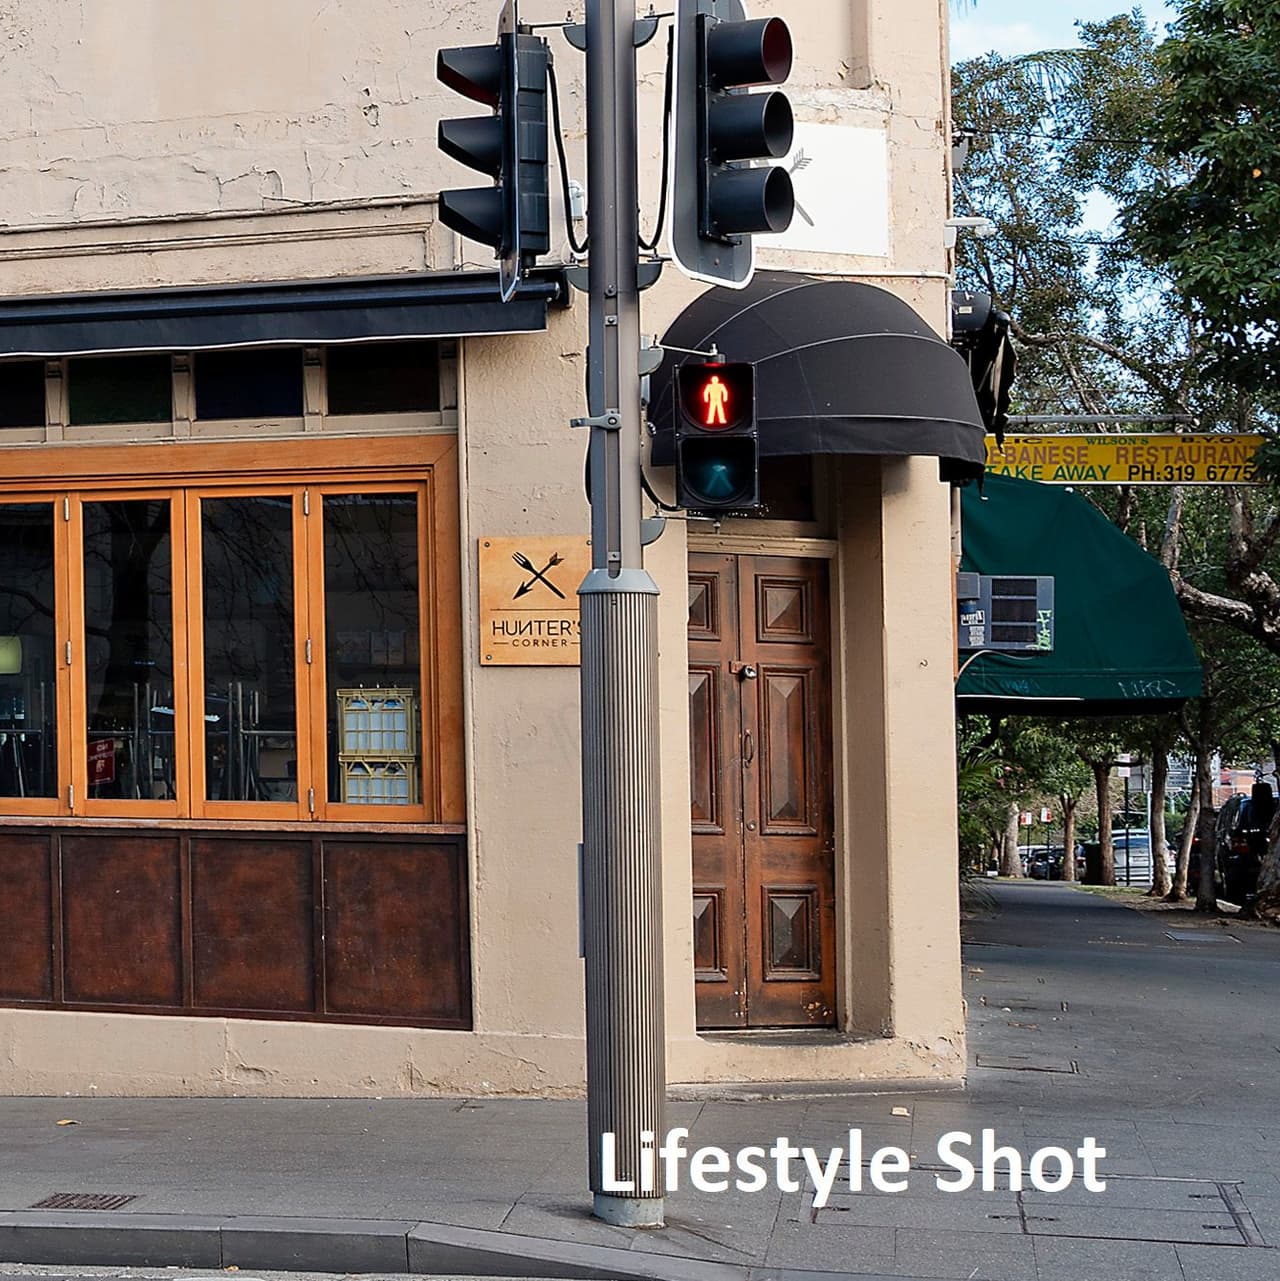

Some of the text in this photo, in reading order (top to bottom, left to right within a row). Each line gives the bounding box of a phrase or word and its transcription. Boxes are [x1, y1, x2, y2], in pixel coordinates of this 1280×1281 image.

[1085, 436, 1149, 446] WILSON'S
[989, 445, 1089, 465] EBANESE
[1052, 464, 1111, 481] AWAY
[512, 638, 568, 647] CORNER
